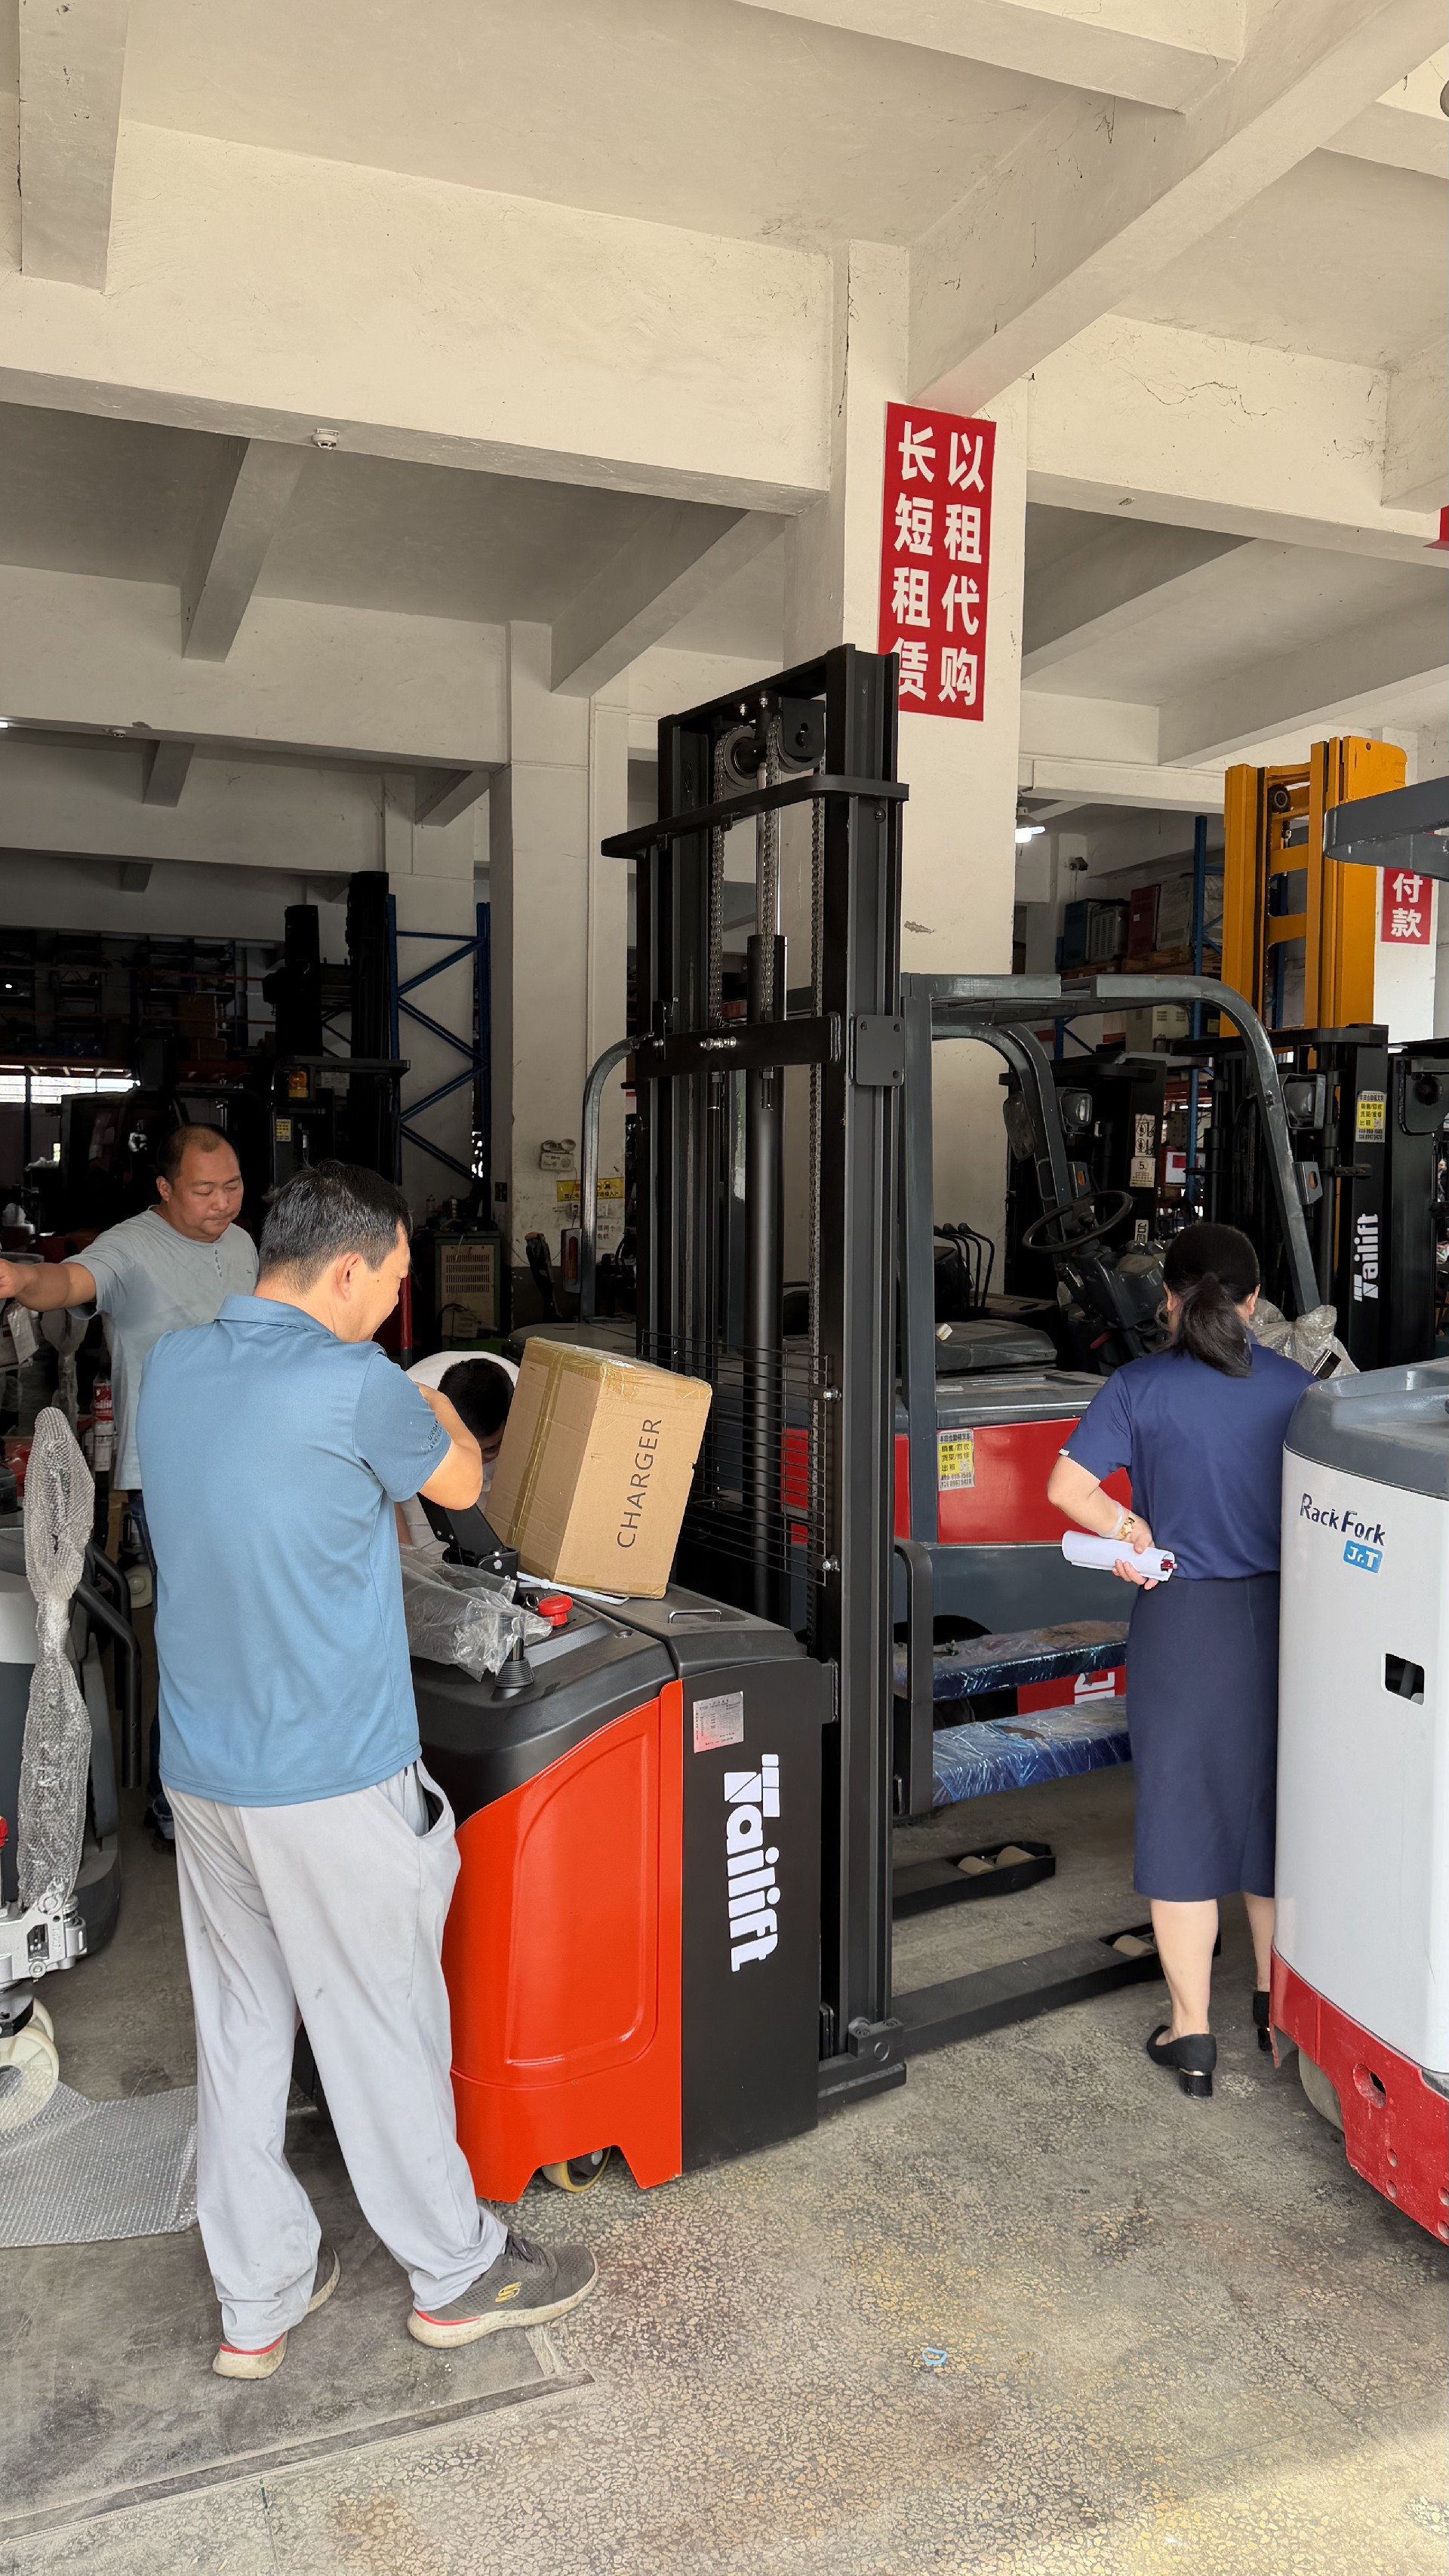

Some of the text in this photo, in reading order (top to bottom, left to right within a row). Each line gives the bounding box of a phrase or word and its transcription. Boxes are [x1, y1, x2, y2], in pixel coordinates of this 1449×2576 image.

[890, 420, 936, 702] 长短租赁
[937, 431, 986, 706] 以租代购
[1391, 873, 1423, 938] 付款
[1353, 1213, 1379, 1302] Tailift
[617, 1419, 662, 1548] CHARGER
[724, 1753, 780, 1972] Tailift
